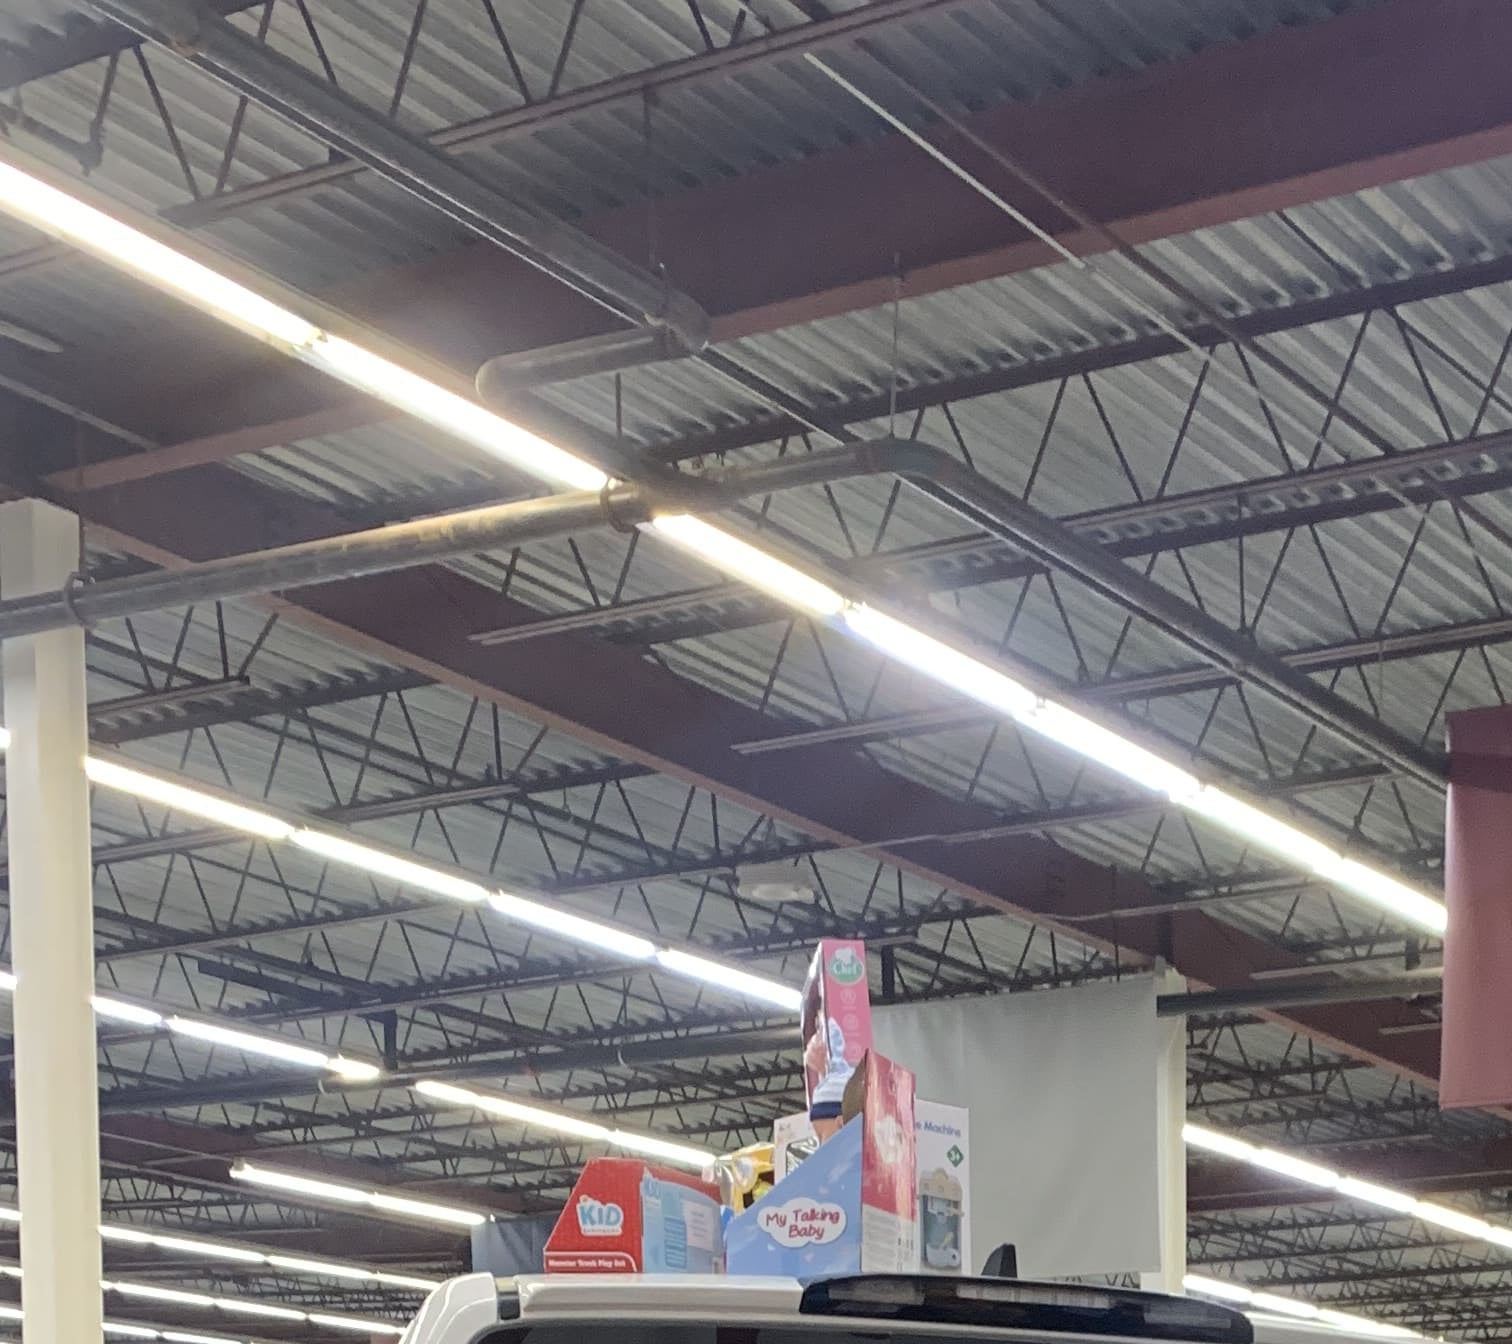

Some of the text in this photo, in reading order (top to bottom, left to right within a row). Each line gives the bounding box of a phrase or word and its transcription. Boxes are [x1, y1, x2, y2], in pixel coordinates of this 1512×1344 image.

[924, 1121, 962, 1138] Machine
[579, 1204, 623, 1227] KID
[766, 1208, 840, 1228] My Talking
[788, 1224, 825, 1240] Baby
